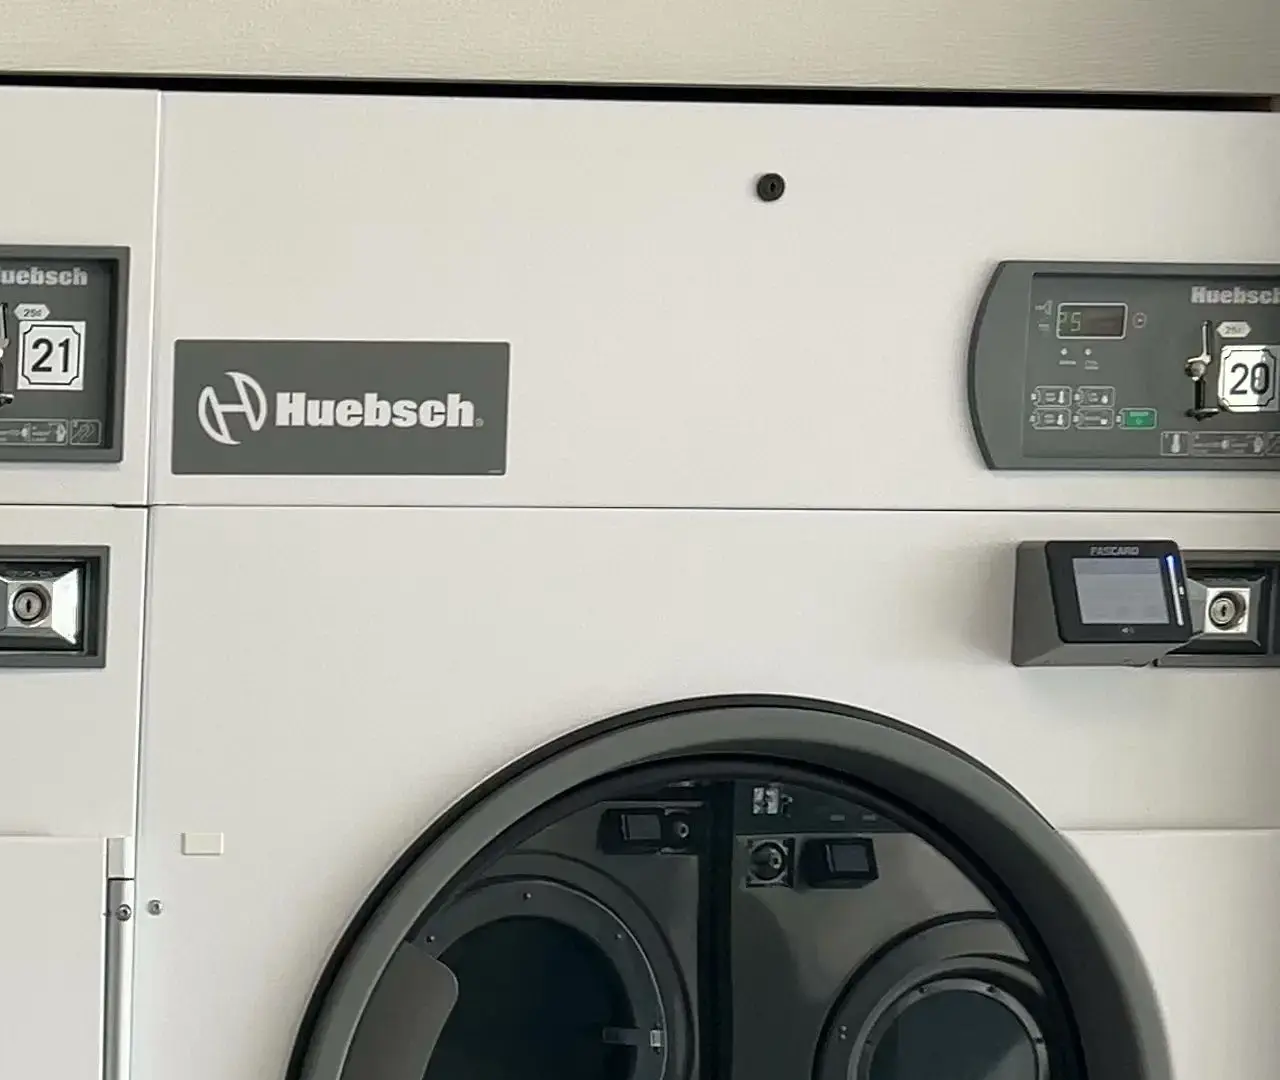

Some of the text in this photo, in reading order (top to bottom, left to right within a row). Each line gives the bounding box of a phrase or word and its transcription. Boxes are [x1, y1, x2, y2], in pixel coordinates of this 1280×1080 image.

[30, 337, 72, 374] 21
[1229, 362, 1271, 396] 20
[275, 391, 475, 428] Huebsch
